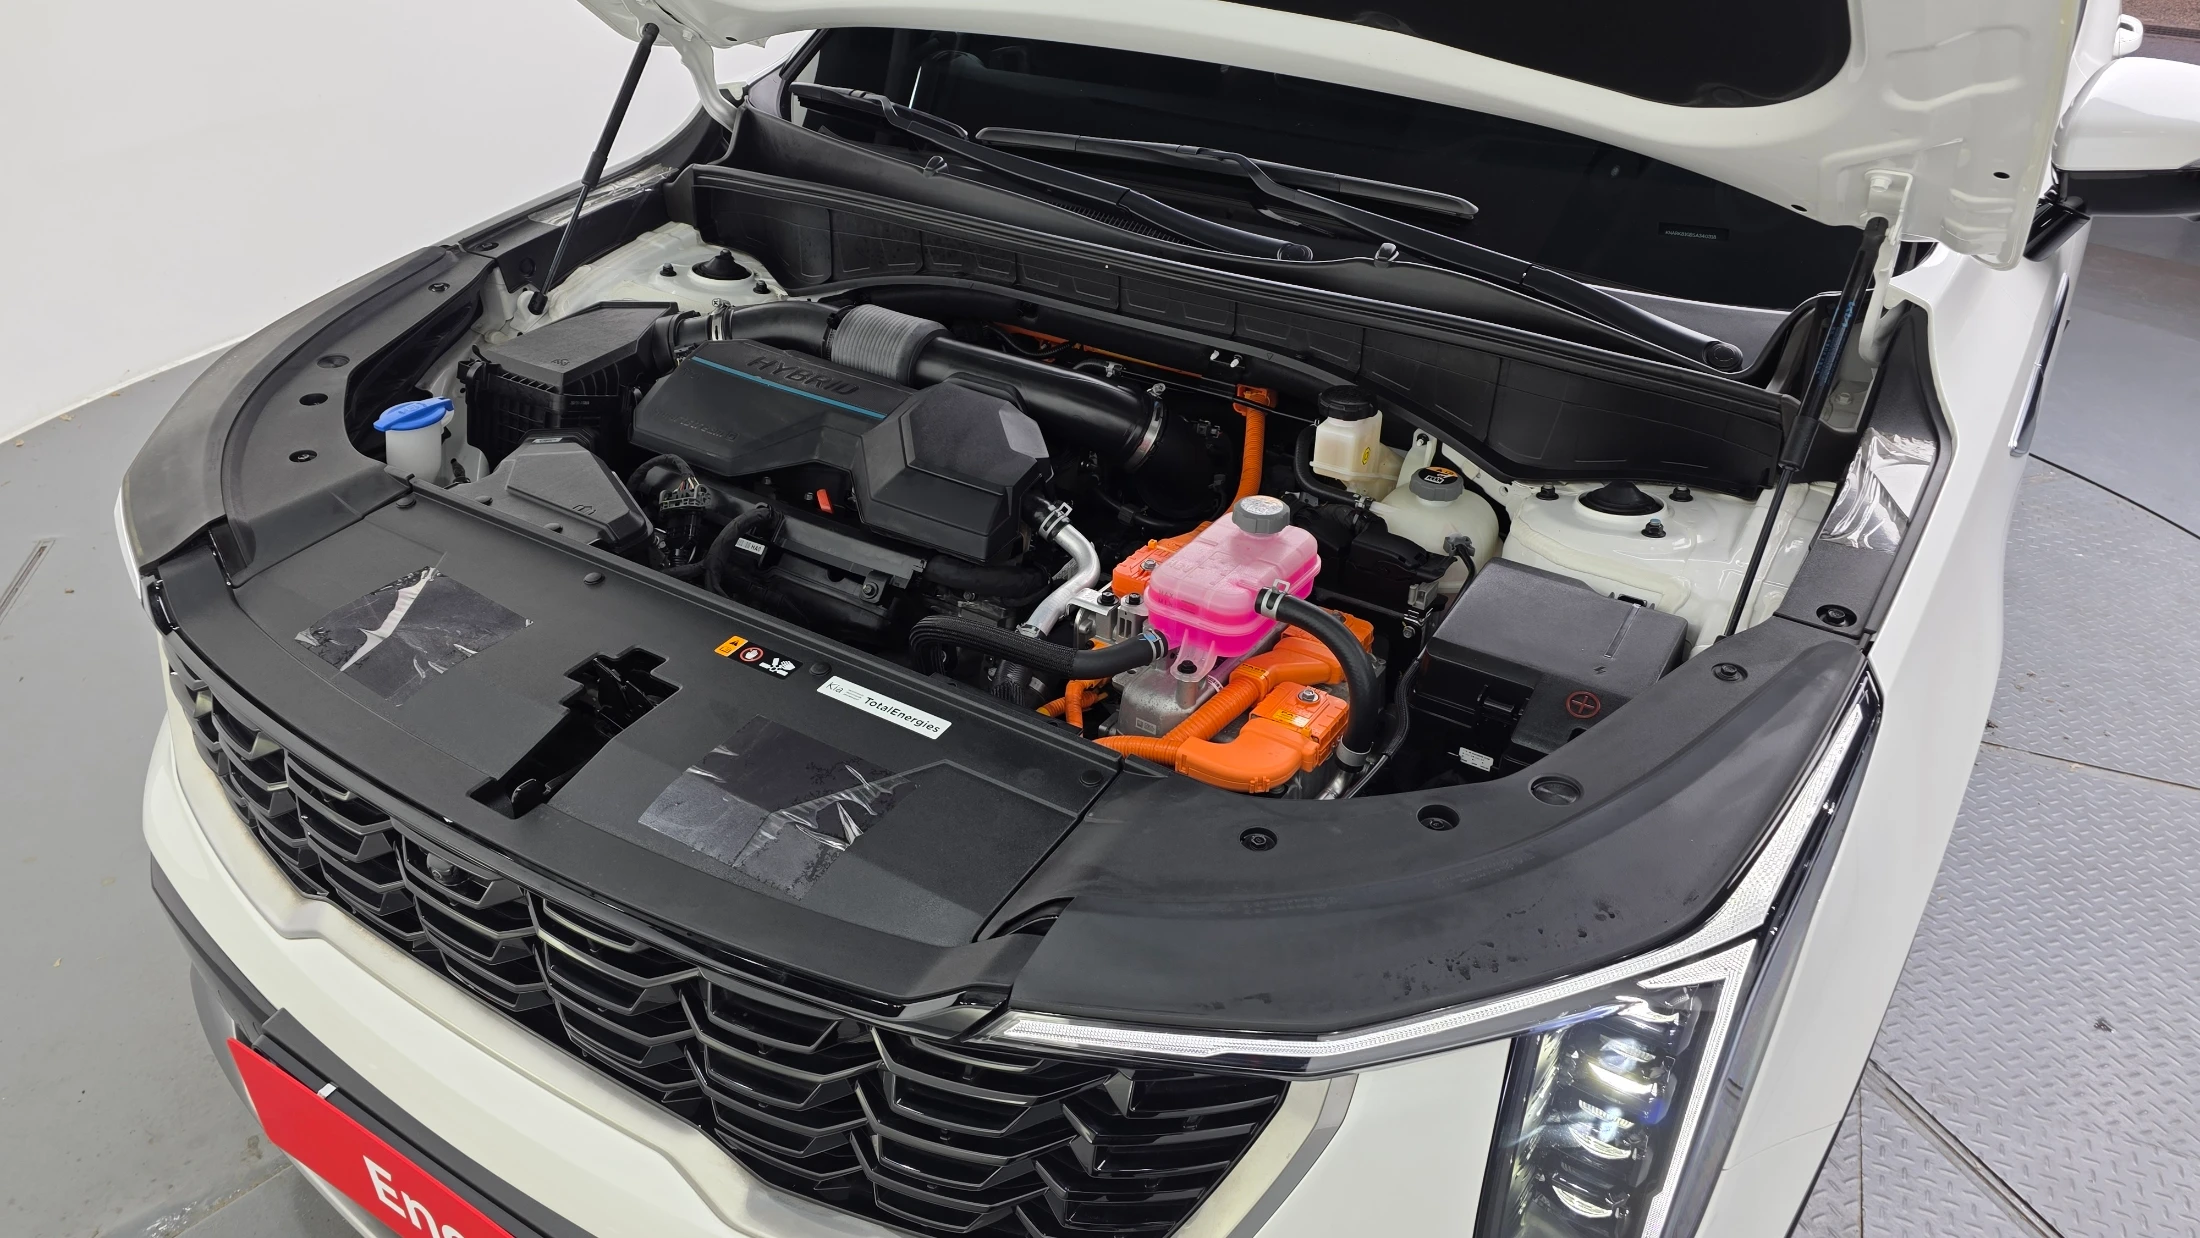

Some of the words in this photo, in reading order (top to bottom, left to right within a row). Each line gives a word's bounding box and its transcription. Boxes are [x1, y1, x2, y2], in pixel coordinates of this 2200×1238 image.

[746, 355, 860, 395] HYBRID
[825, 681, 845, 694] Kia
[864, 696, 941, 733] TotalEnergies
